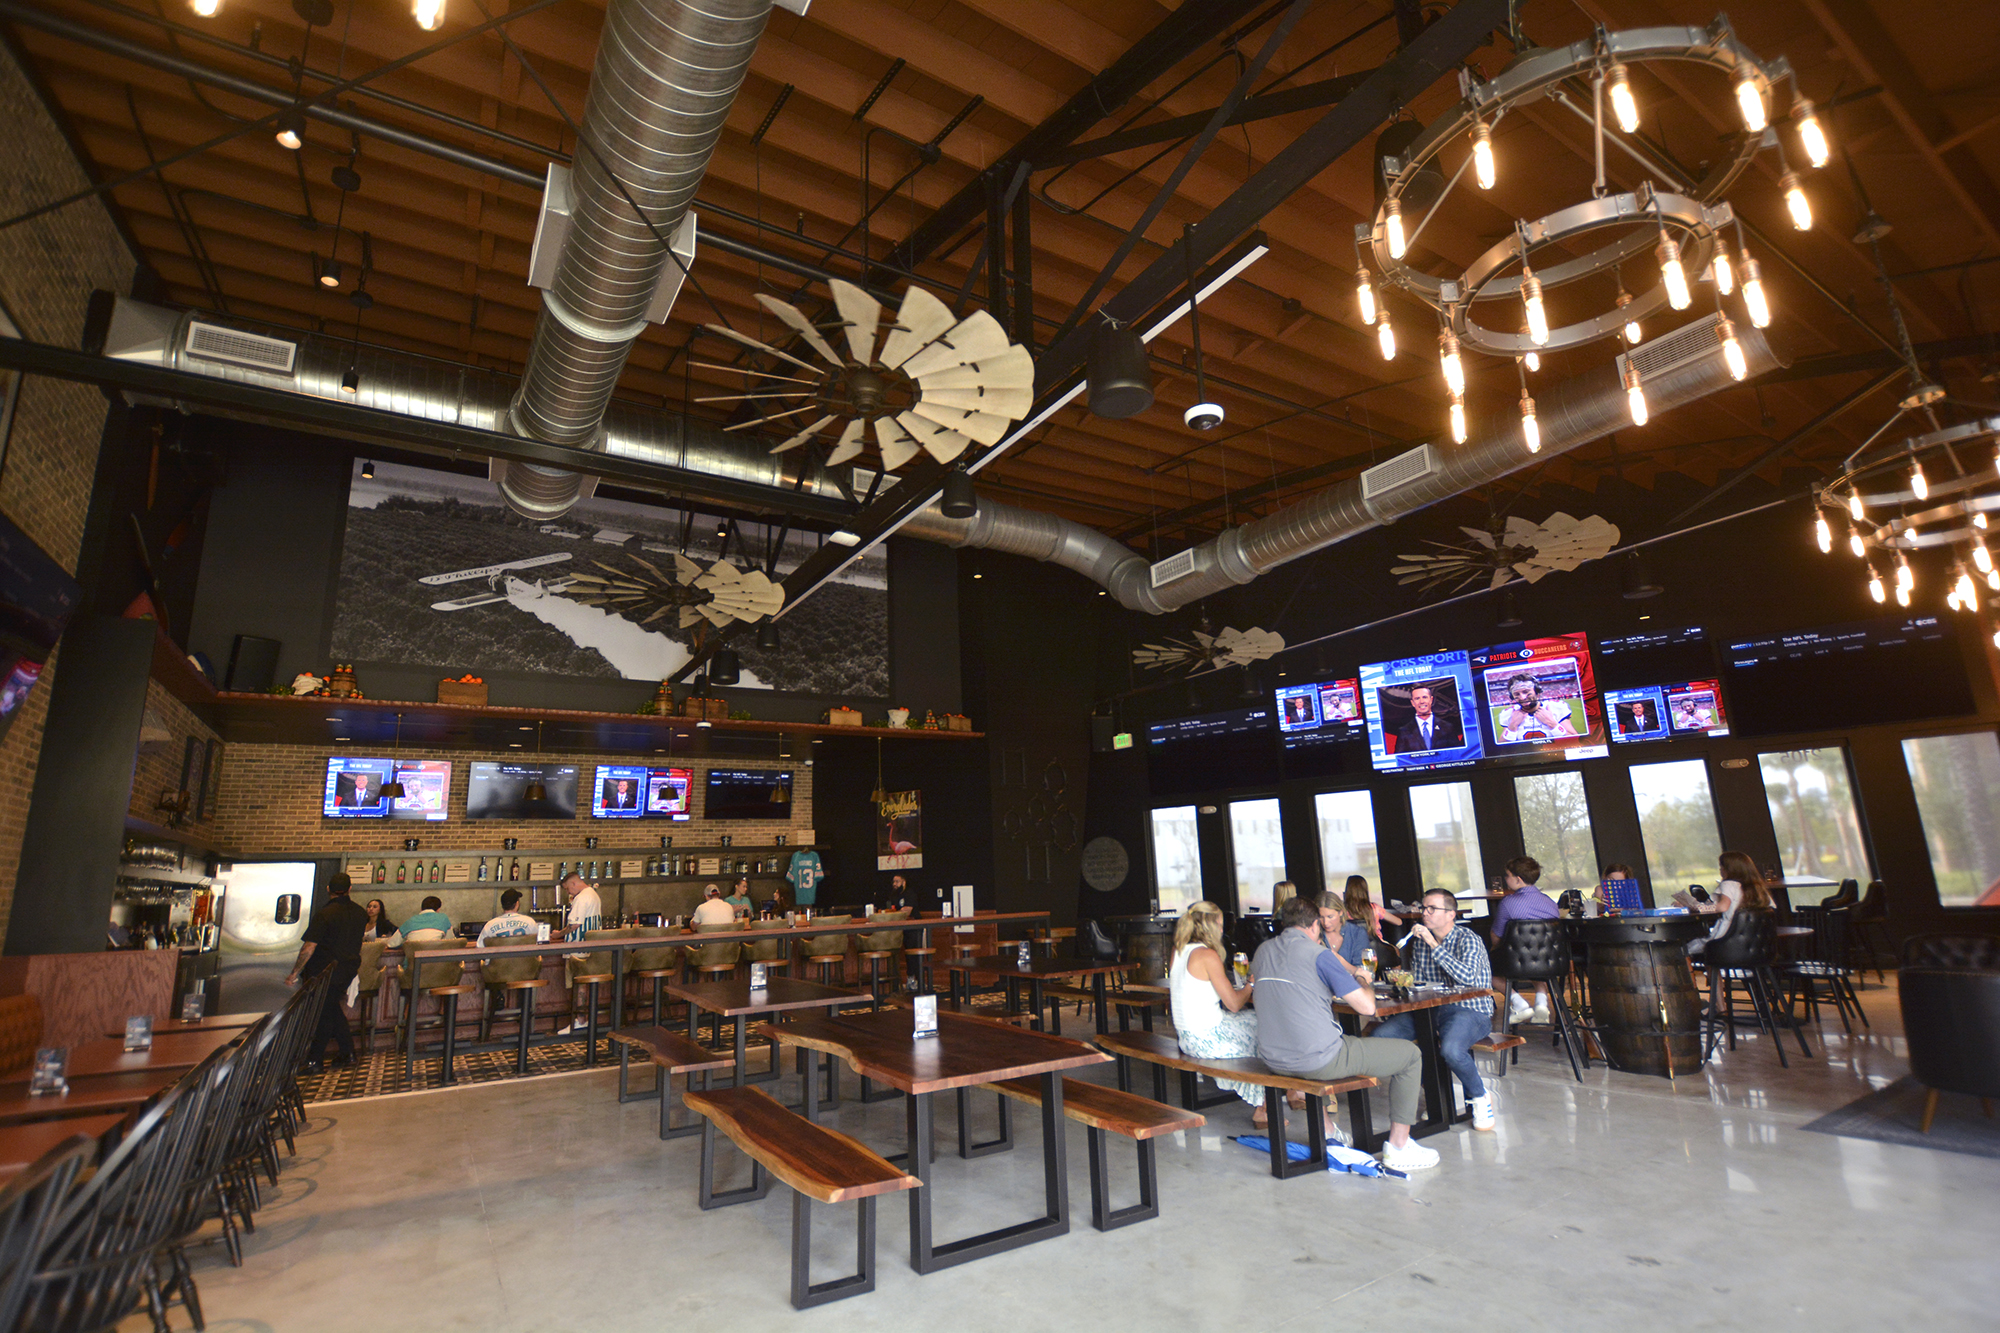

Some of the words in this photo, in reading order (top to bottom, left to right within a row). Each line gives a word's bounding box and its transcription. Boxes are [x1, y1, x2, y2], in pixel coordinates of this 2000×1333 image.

[1533, 644, 1567, 655] BUCCANEERS
[1489, 651, 1517, 661] PATRIOTS
[1391, 657, 1416, 668] CBS
[1394, 669, 1405, 677] THE
[1415, 665, 1432, 674] TODAY
[798, 868, 814, 889] 13
[490, 922, 505, 934] STILL
